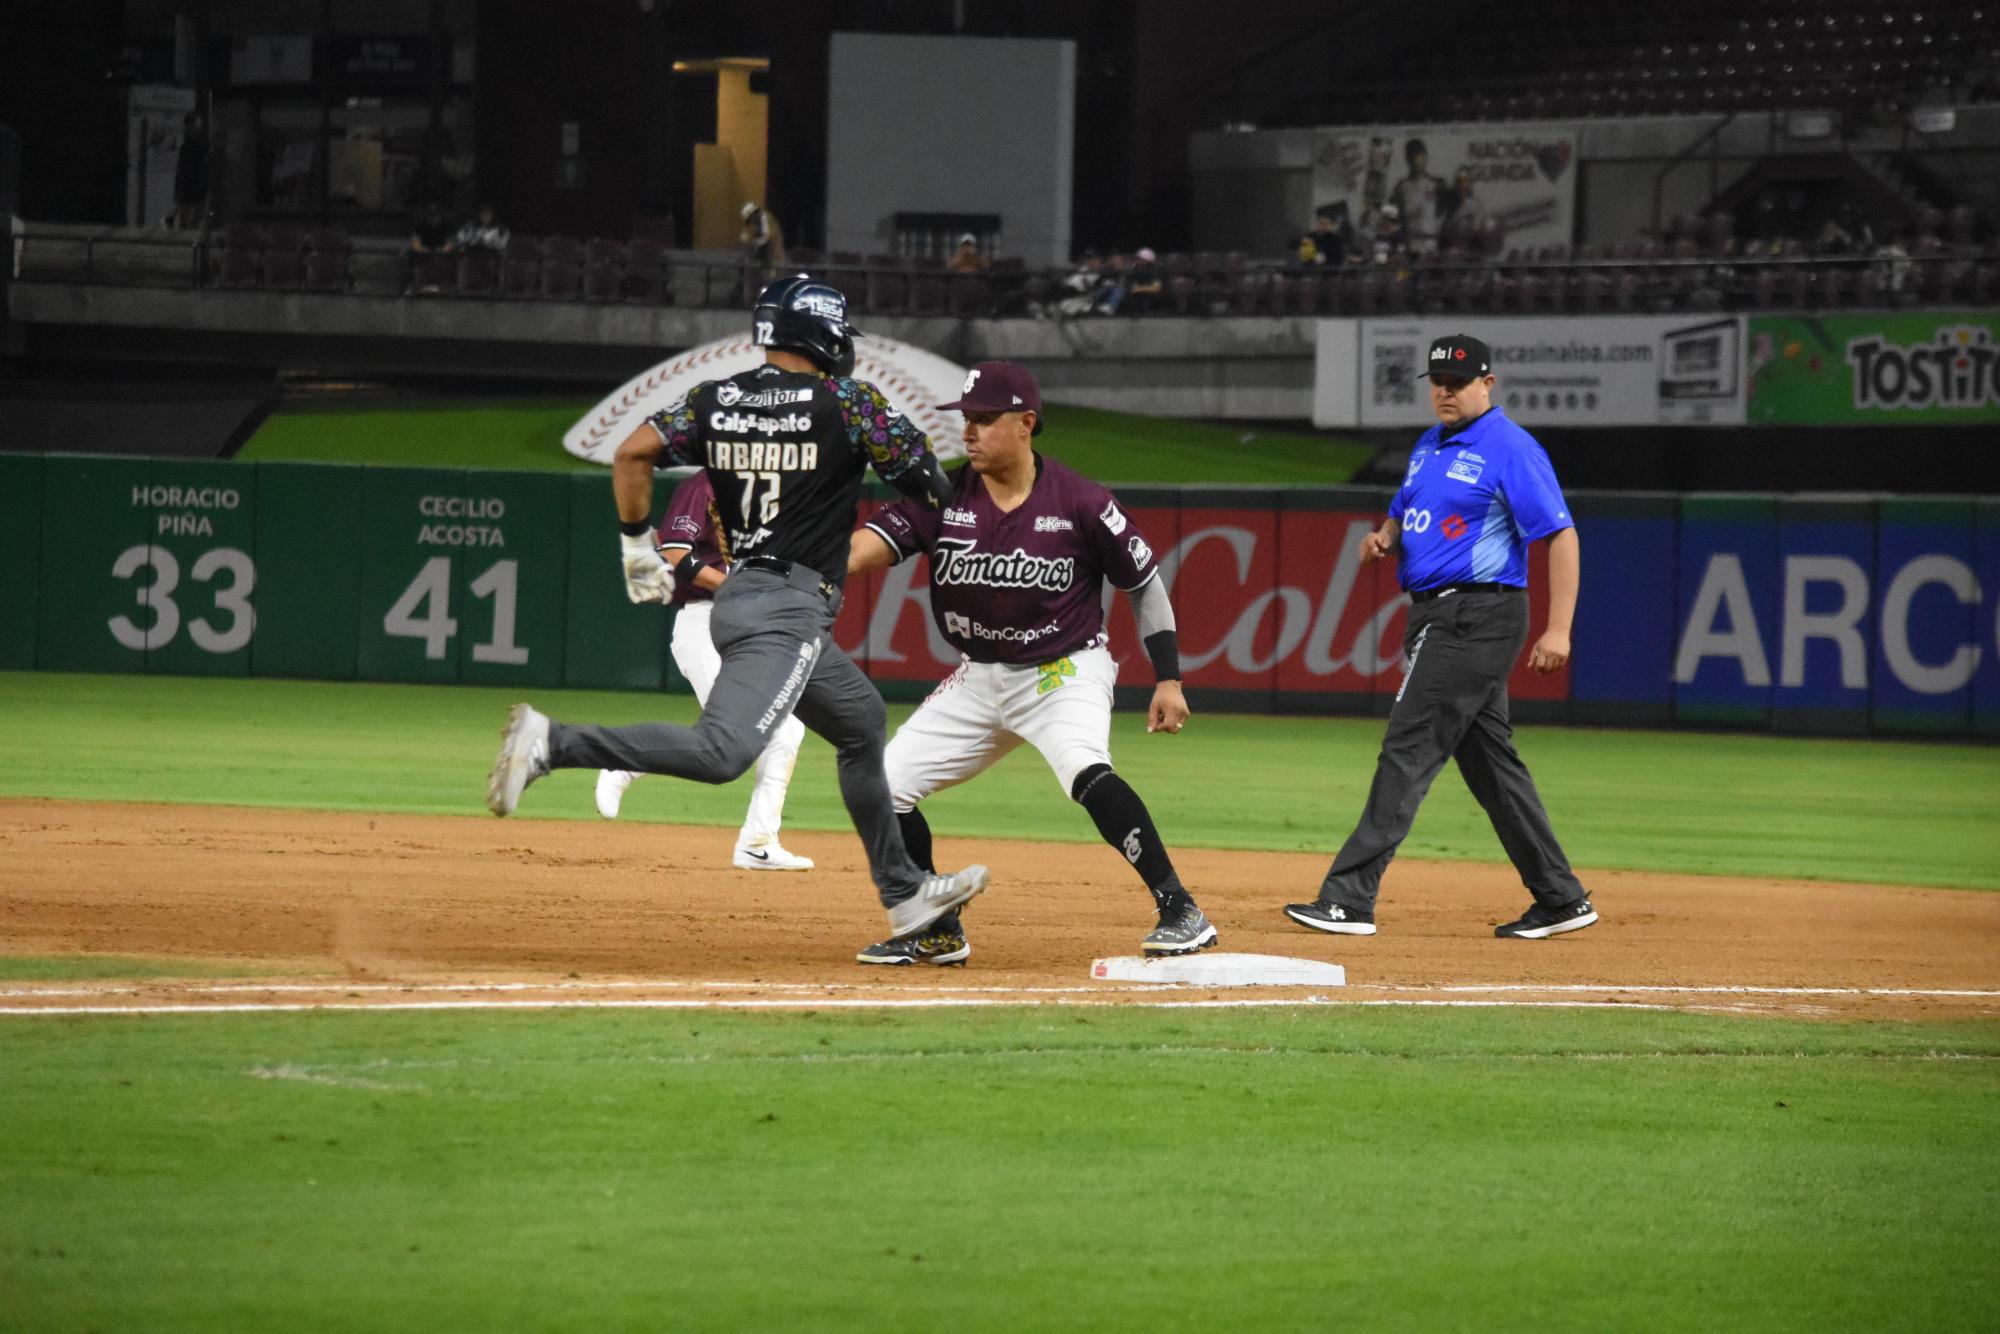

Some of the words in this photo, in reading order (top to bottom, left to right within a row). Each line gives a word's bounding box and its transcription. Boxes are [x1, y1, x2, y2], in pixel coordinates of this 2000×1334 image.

[706, 441, 818, 470] LABRADA
[132, 485, 239, 510] HORACIO
[158, 512, 213, 537] PIÑA
[419, 497, 504, 519] CECILIO
[736, 471, 781, 529] 72
[417, 524, 504, 547] ACOSTA
[935, 537, 1075, 592] Tomateros
[107, 545, 257, 654] 33
[383, 557, 529, 665] 41
[1673, 552, 2000, 695] ARC
[756, 657, 807, 734] caliente.mx
